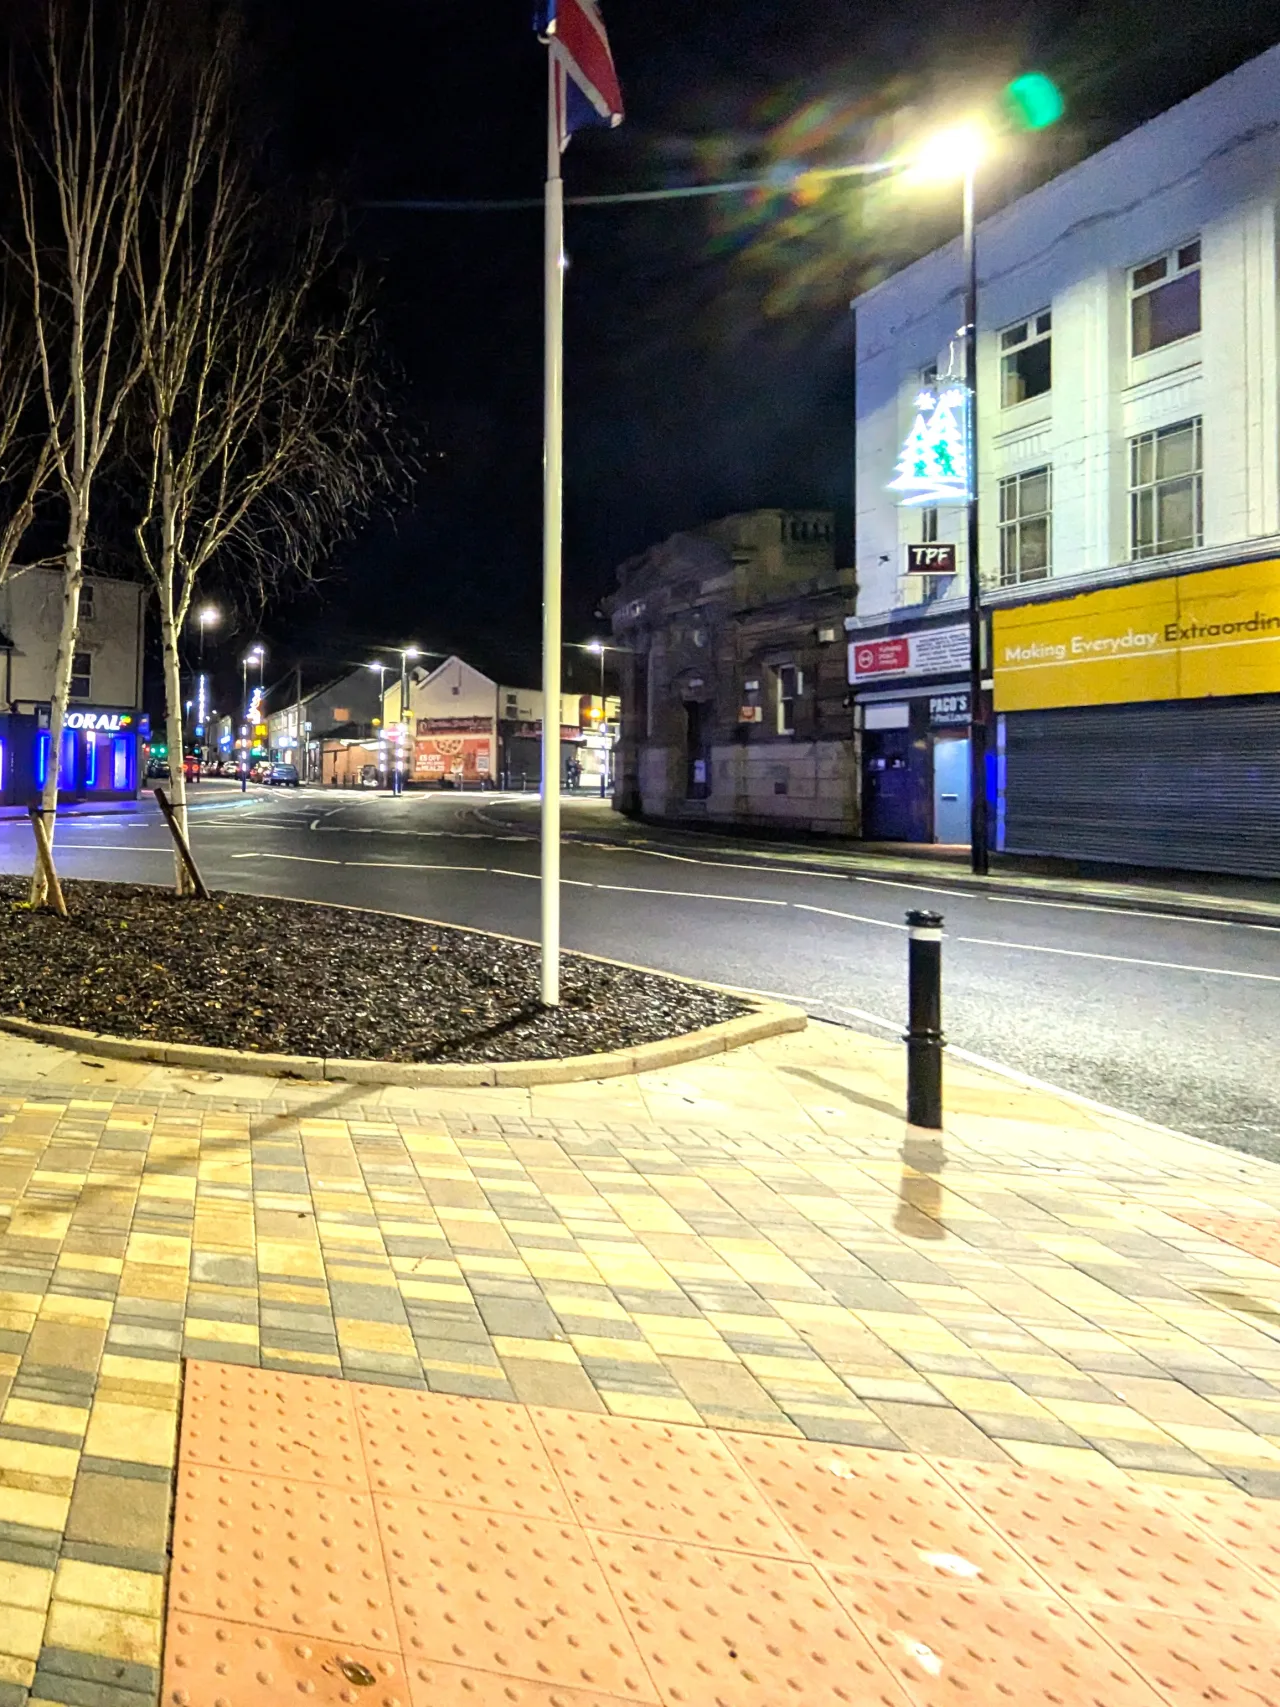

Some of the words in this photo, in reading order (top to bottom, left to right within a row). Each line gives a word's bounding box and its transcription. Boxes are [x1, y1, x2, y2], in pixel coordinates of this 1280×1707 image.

[912, 547, 951, 565] TPF
[1004, 642, 1066, 662] Making
[1071, 628, 1159, 654] Everyday
[1164, 610, 1280, 643] Extraordin
[929, 696, 967, 713] PACO'S
